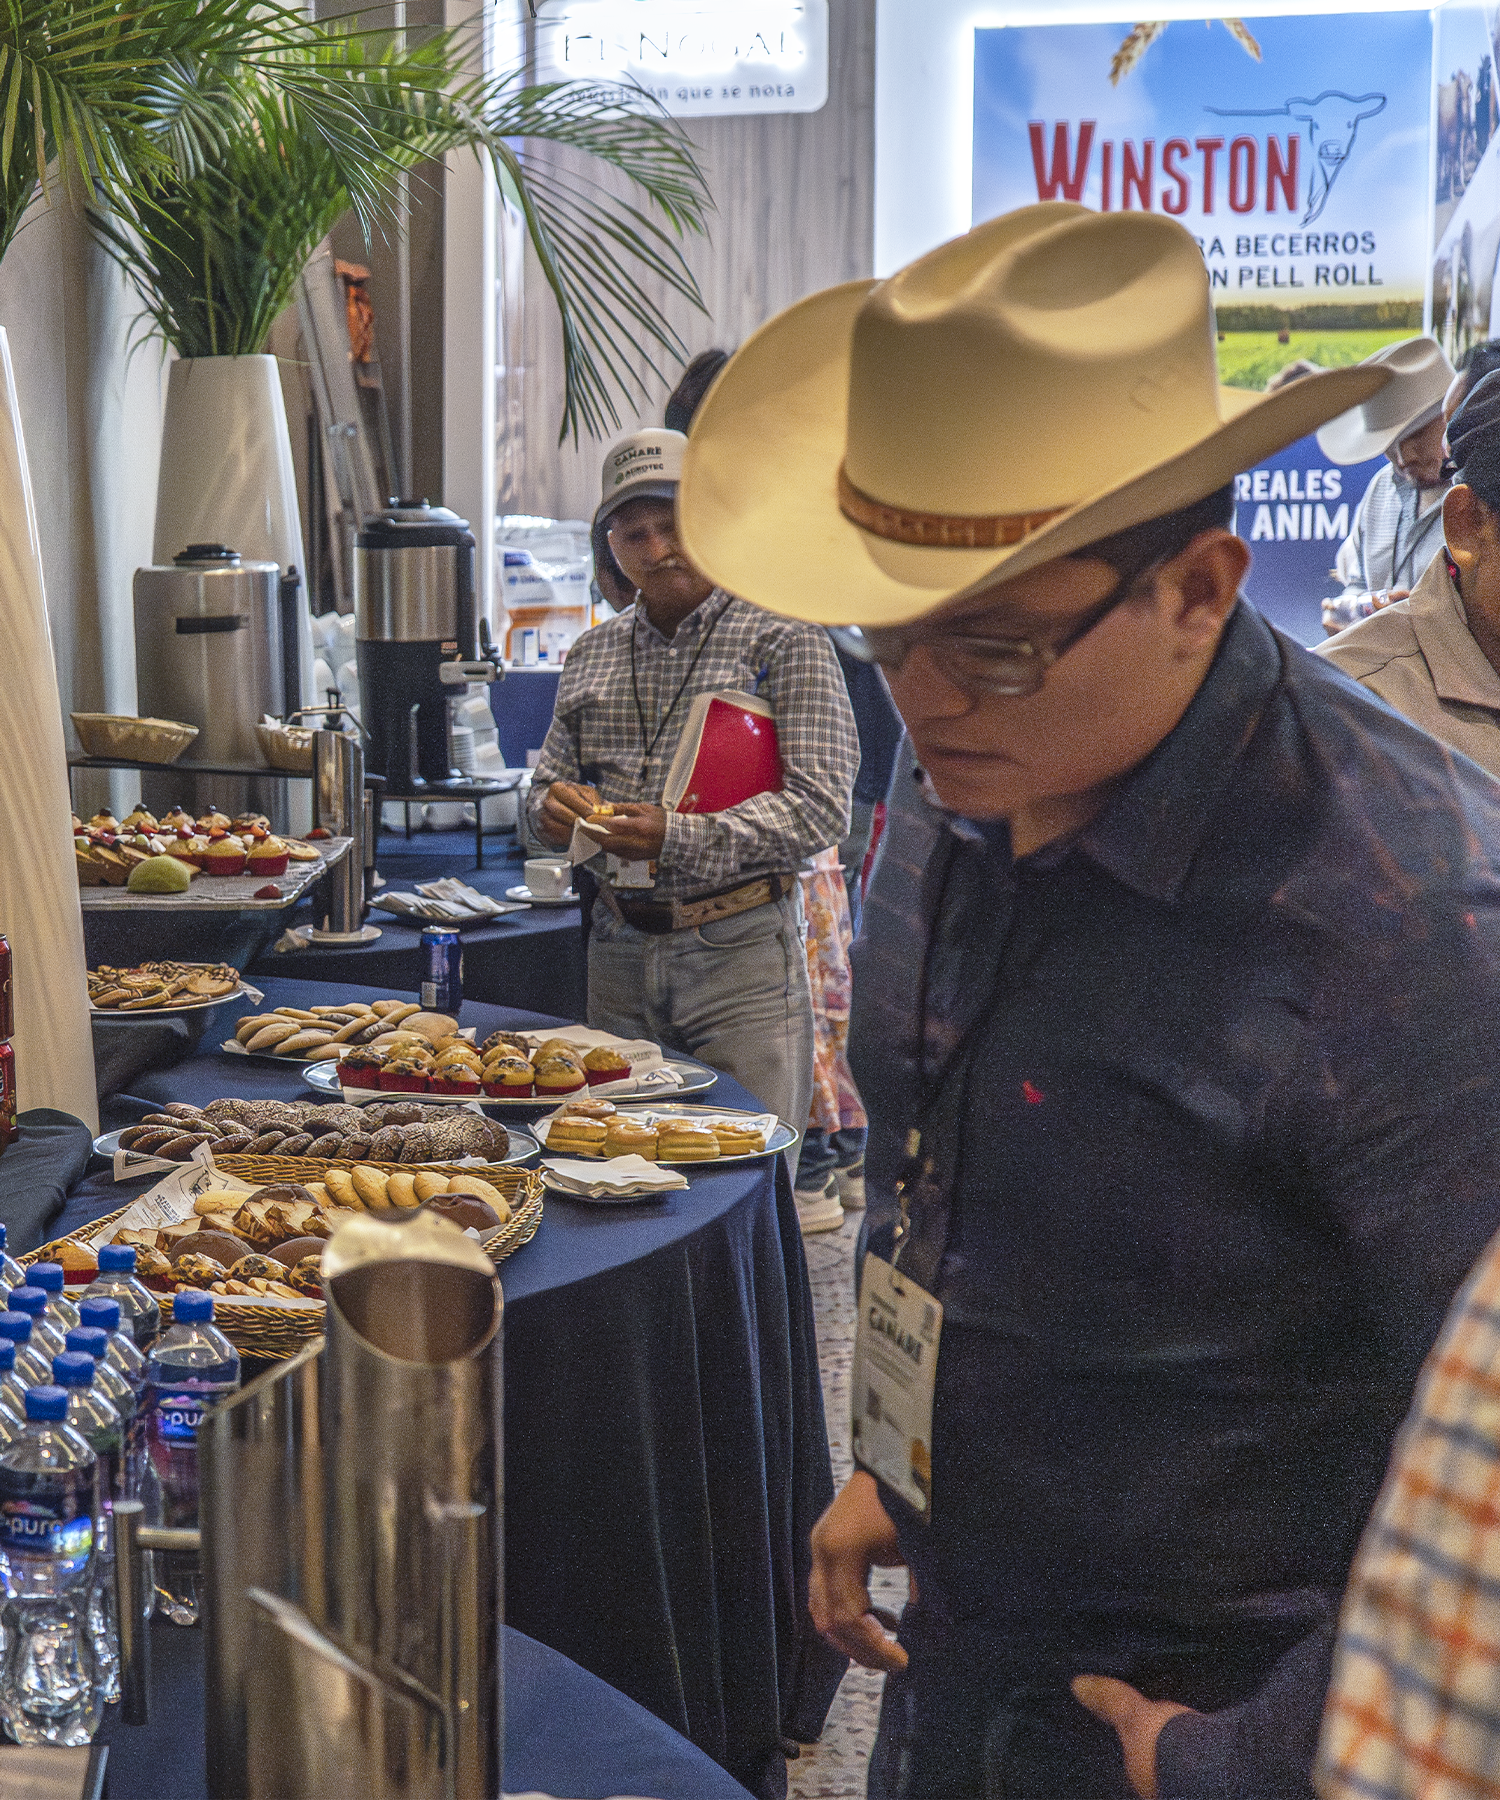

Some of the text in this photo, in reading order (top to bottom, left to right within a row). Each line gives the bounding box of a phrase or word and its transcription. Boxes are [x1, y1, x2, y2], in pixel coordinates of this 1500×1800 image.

[677, 85, 714, 103] que
[721, 84, 742, 99] se
[749, 82, 796, 98] nota
[1028, 119, 1300, 216] WINSTON
[1235, 231, 1376, 258] BECERROS
[1238, 264, 1304, 288] PELL
[1314, 262, 1384, 287] ROLL
[1234, 469, 1343, 502] REALES
[1251, 502, 1350, 541] ANIM
